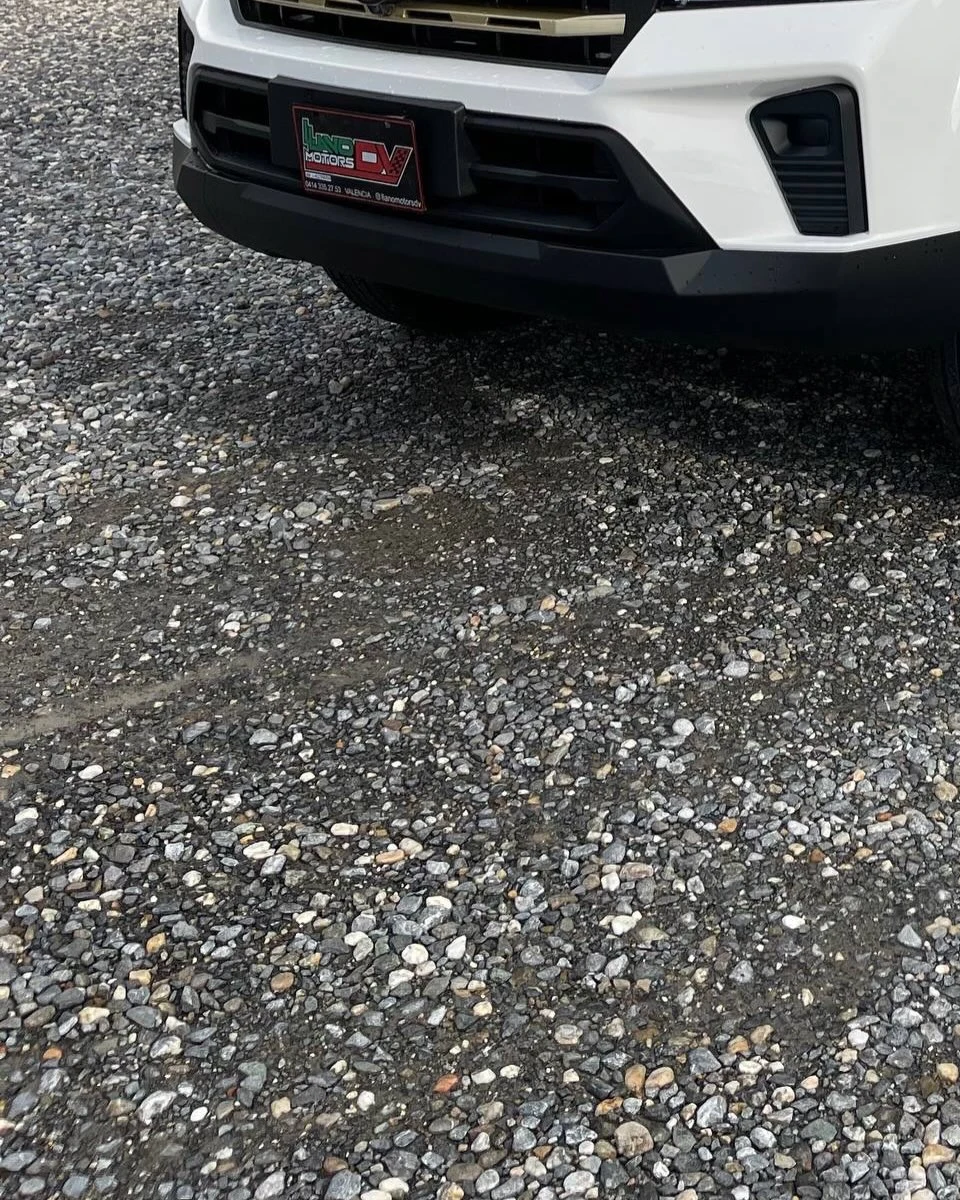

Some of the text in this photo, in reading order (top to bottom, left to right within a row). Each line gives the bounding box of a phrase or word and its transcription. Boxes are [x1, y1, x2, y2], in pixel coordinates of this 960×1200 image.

[305, 151, 354, 169] MOTORS
[355, 139, 414, 176] DV
[335, 185, 341, 193] 53
[344, 187, 371, 199] VALENCIA
